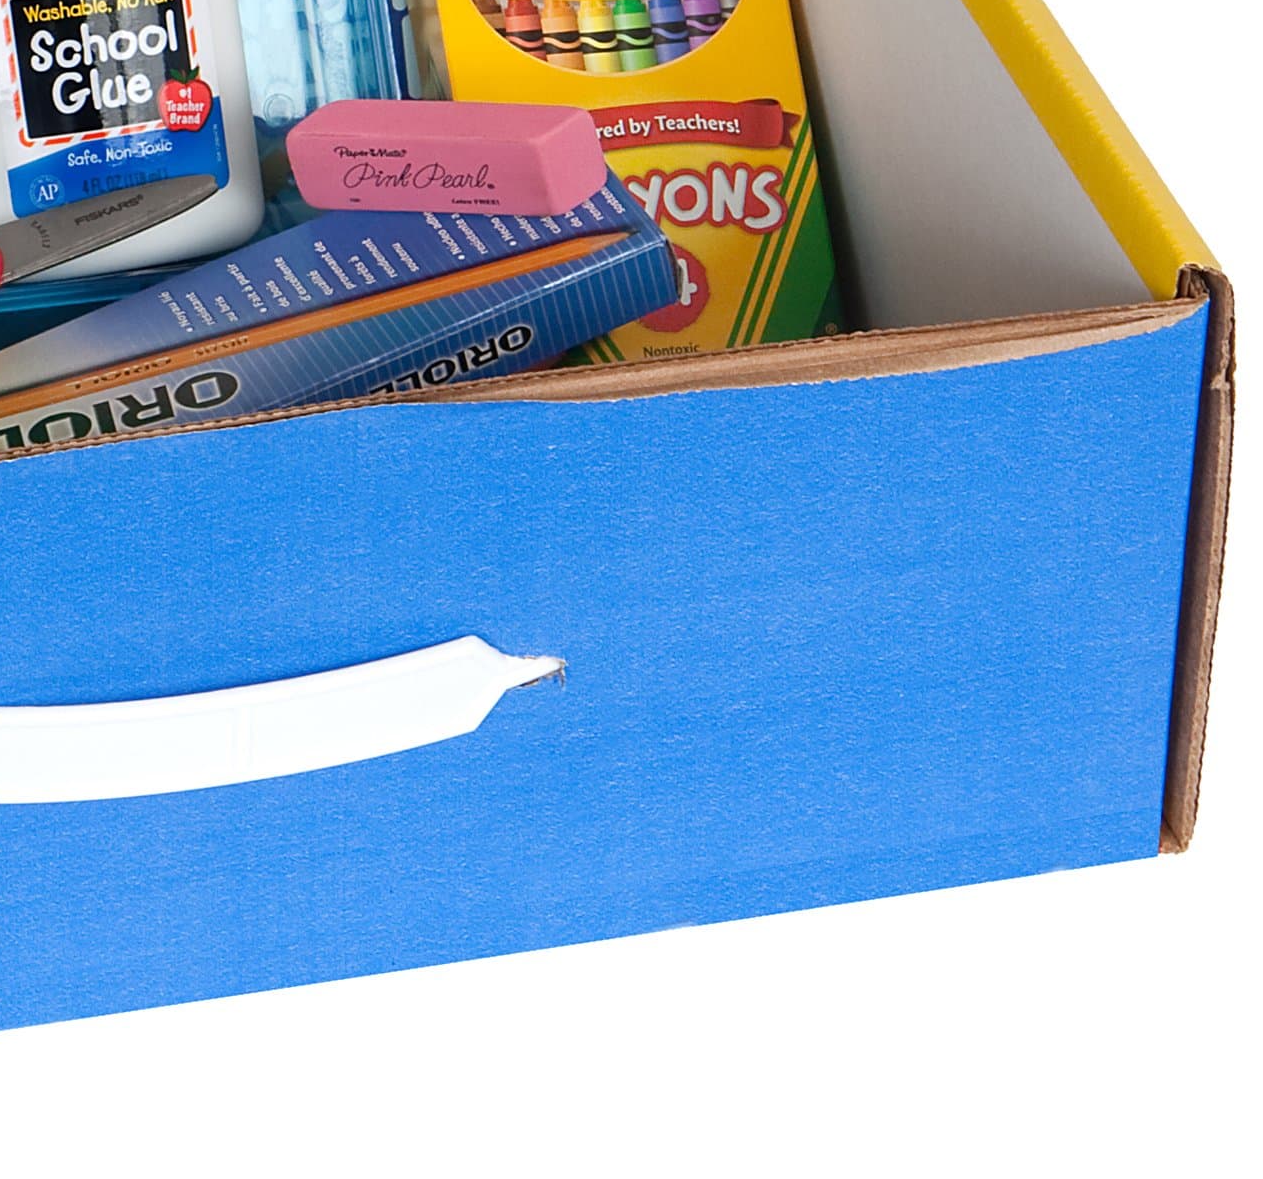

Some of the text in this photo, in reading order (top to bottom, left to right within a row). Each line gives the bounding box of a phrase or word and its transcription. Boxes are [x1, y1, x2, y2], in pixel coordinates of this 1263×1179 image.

[29, 9, 178, 73] School
[51, 68, 154, 115] Glue
[629, 118, 651, 137] by
[654, 113, 742, 134] Teachers!
[343, 161, 489, 190] Pink Pearl
[74, 197, 141, 226] FISKARS
[628, 166, 783, 230] YONS
[642, 342, 701, 358] Nontoxic
